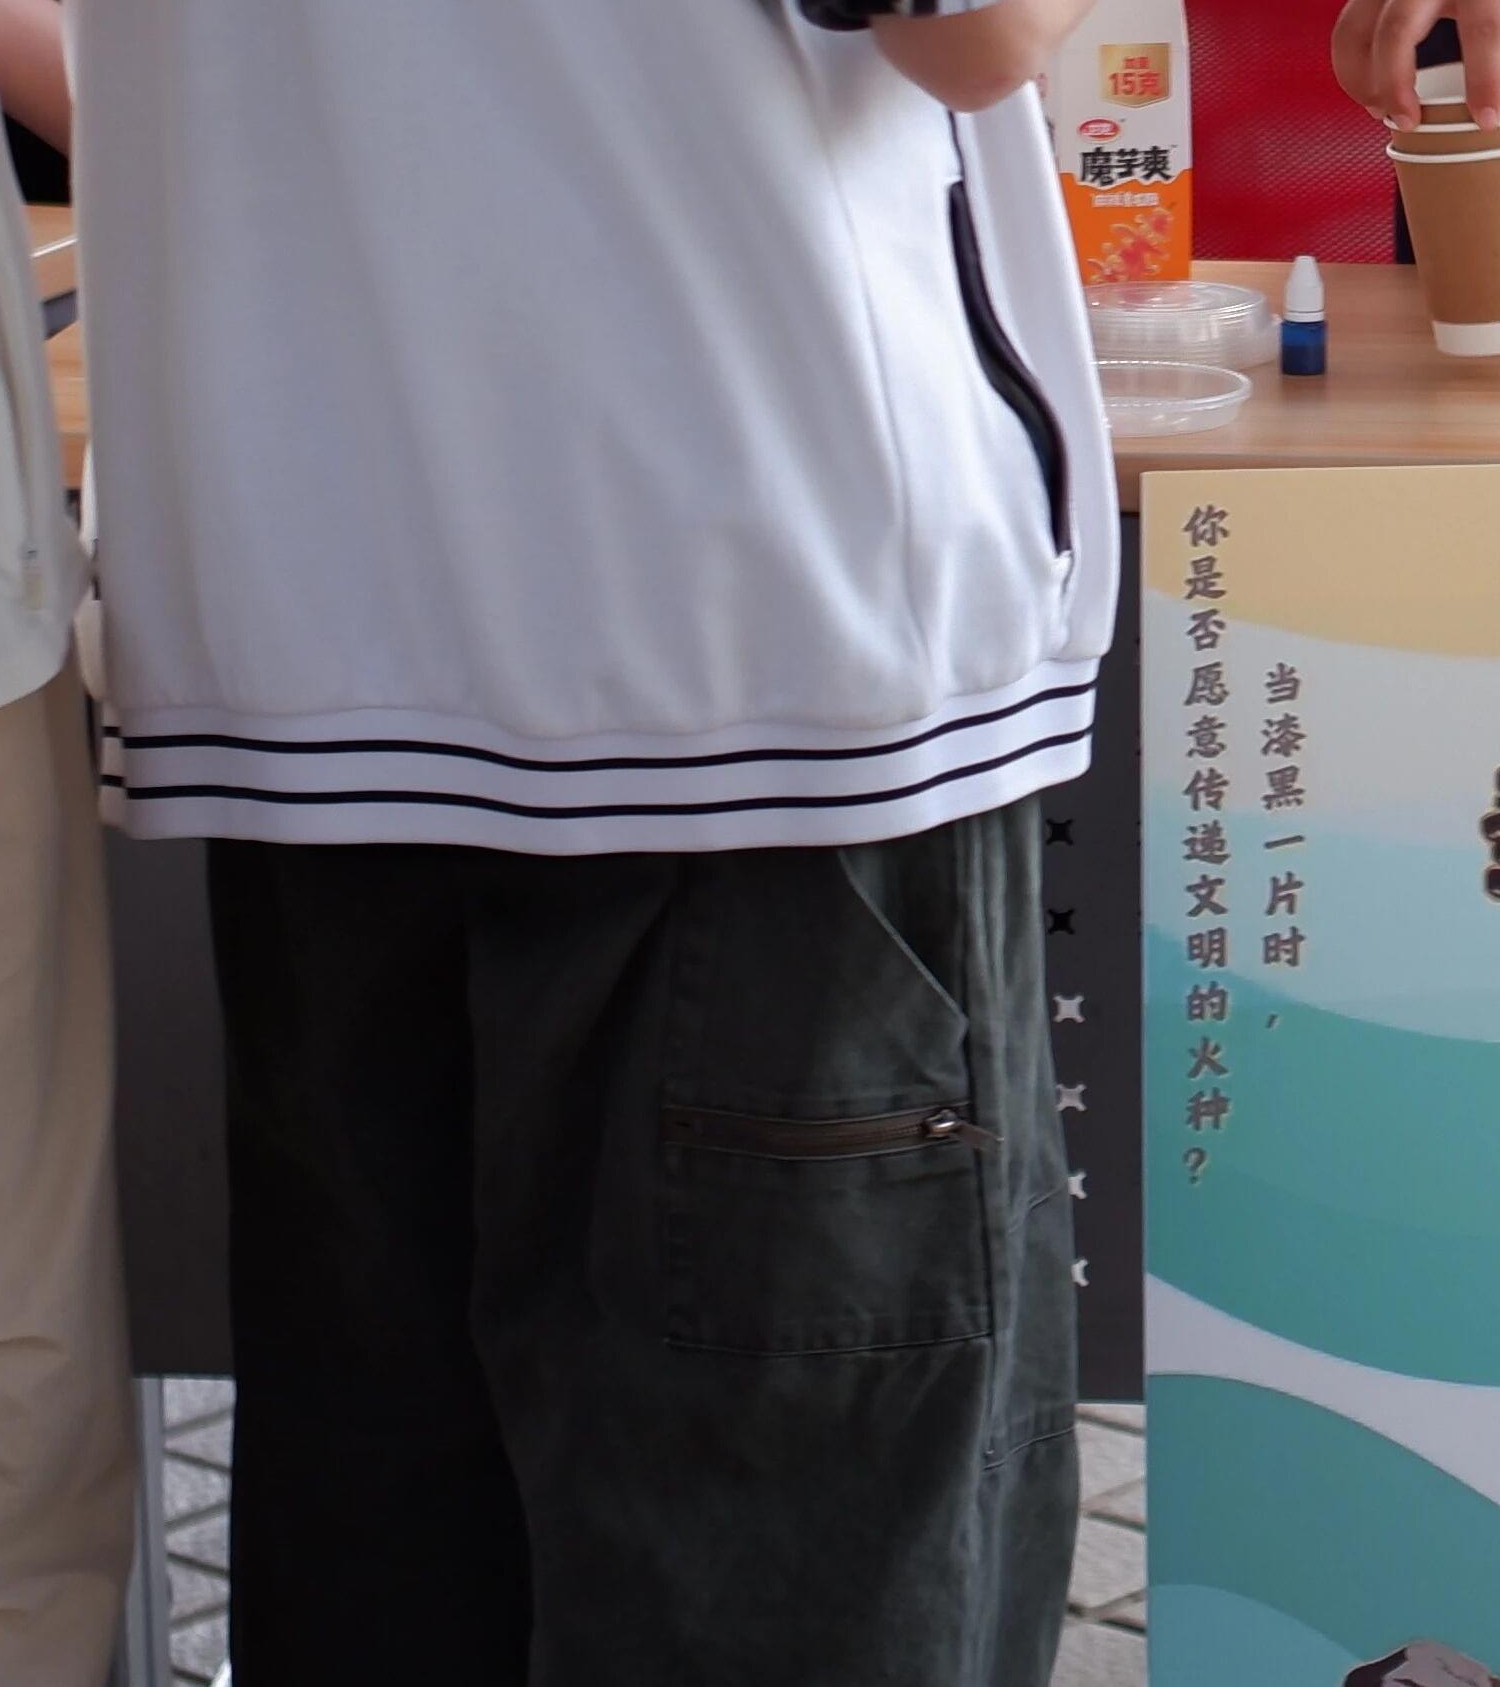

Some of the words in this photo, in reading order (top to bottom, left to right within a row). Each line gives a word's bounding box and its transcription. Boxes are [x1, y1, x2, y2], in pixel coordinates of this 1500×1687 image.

[1107, 70, 1163, 97] 15克
[1078, 145, 1173, 187] 魔芋爽
